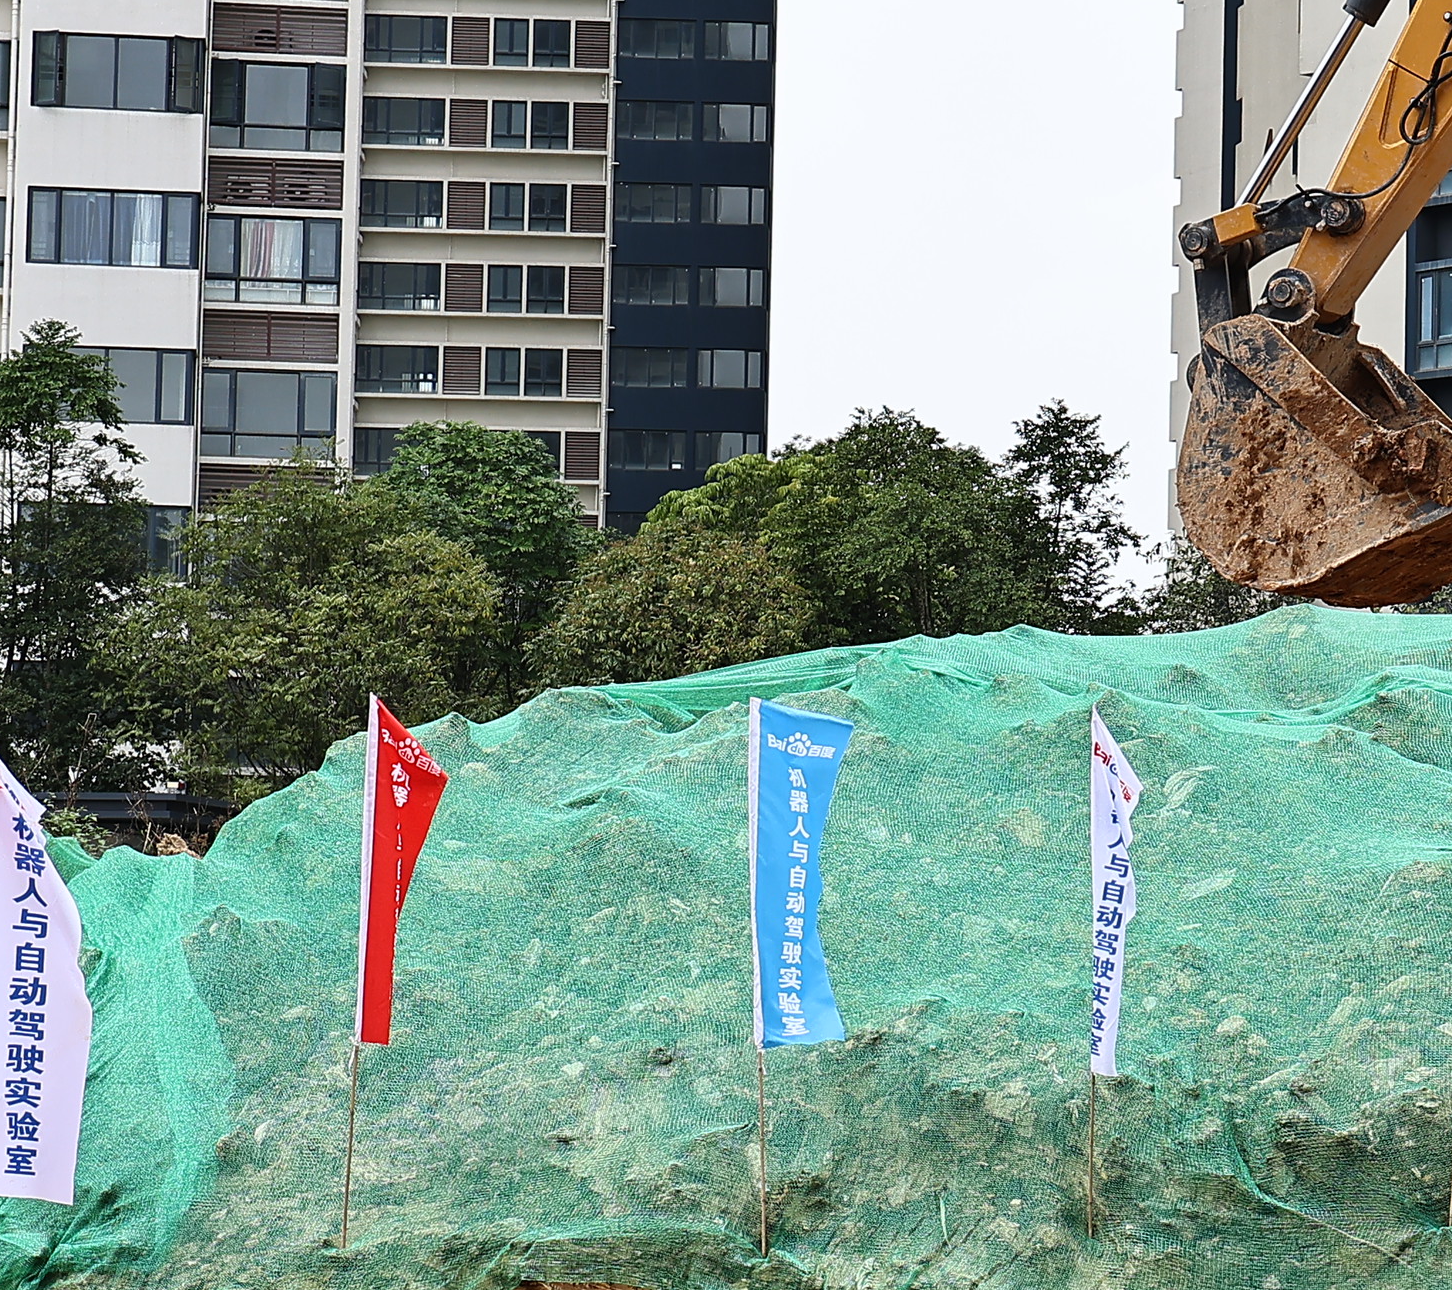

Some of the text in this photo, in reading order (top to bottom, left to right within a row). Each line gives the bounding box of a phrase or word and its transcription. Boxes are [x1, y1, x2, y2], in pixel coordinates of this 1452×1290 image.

[777, 766, 811, 1038] 机器人与自动驾驶实验室
